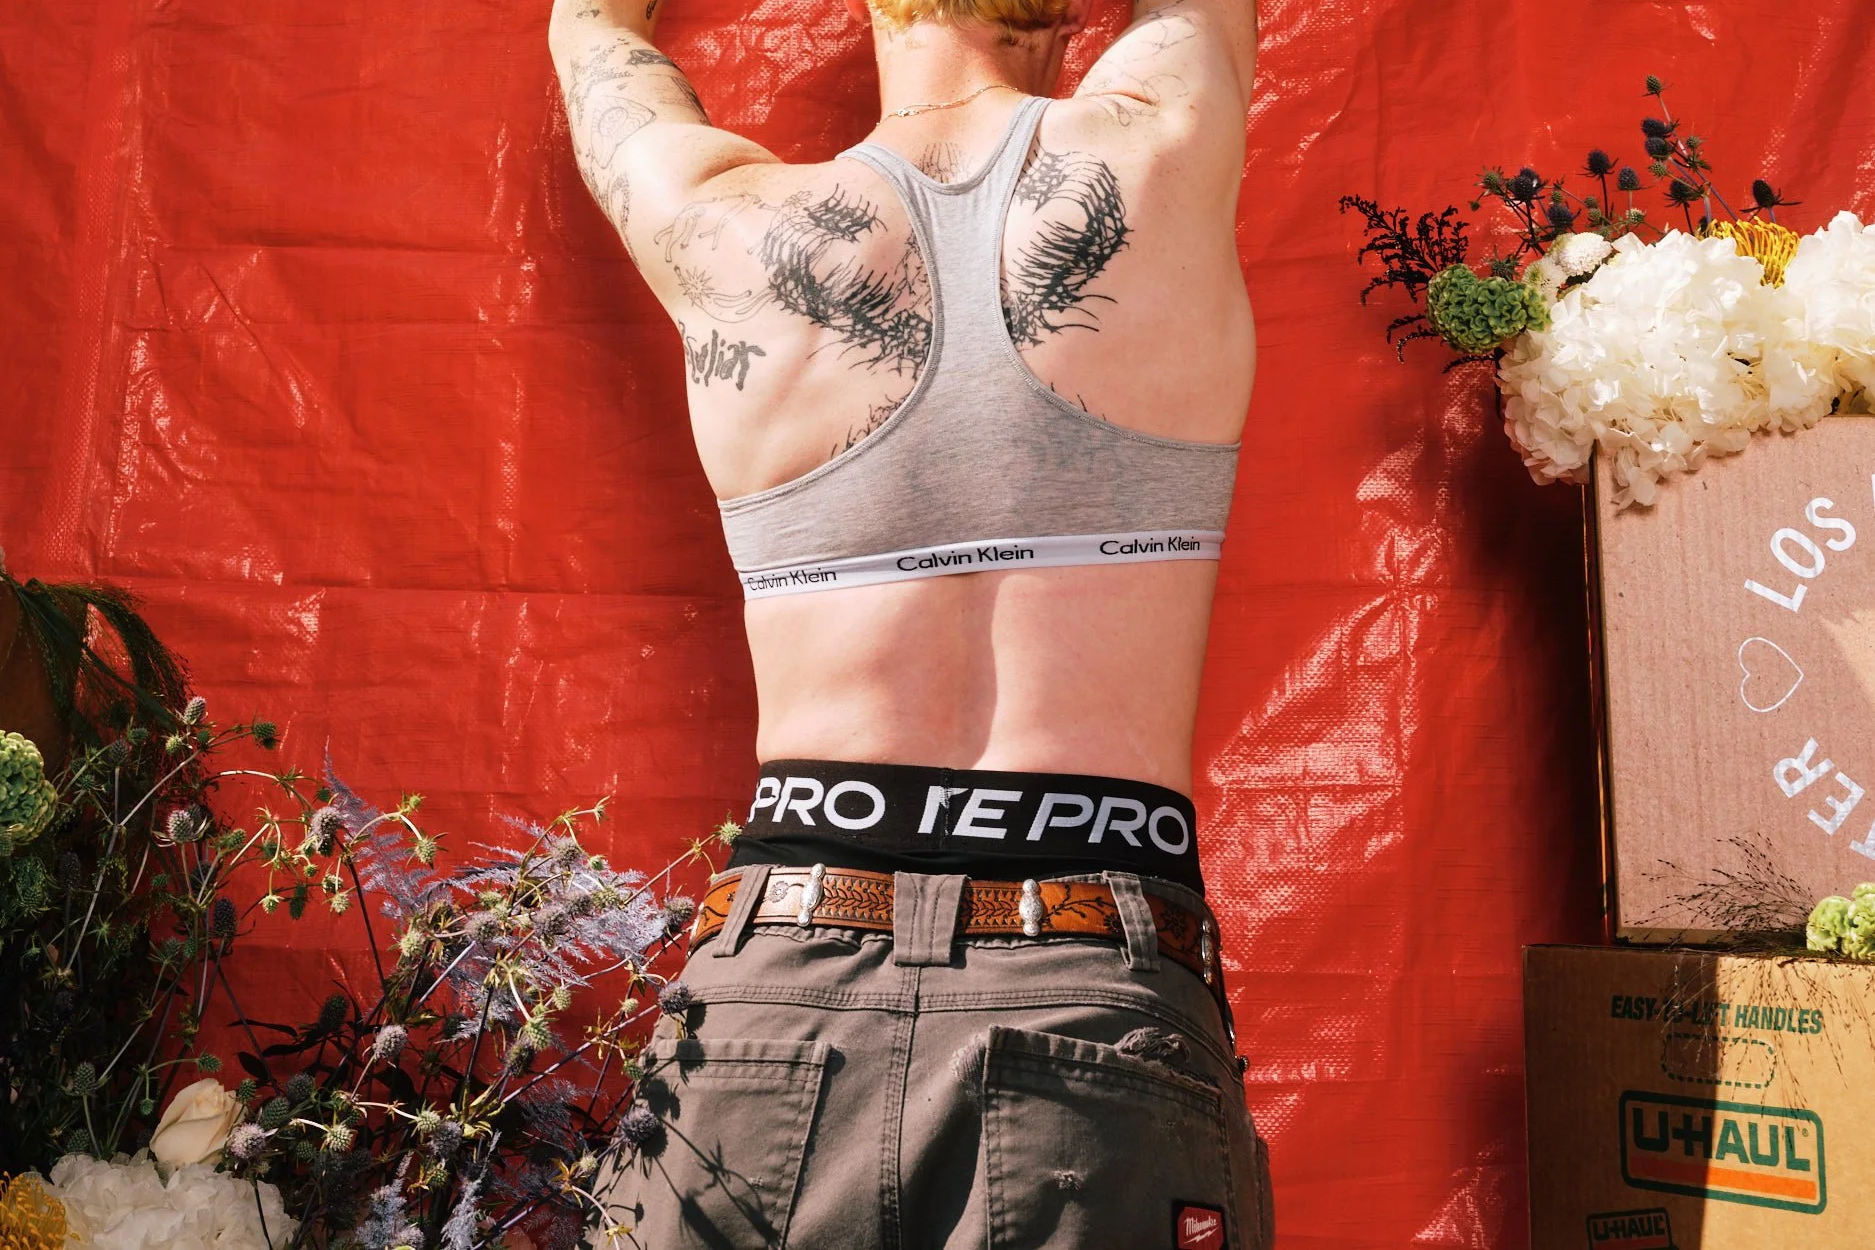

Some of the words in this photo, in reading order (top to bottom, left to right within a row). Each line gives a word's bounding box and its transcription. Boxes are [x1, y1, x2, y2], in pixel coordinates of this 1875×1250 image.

[896, 550, 972, 571] Calvin
[976, 544, 1034, 563] Klein
[1099, 537, 1164, 556] Calvin
[1167, 536, 1201, 552] Klein
[1743, 496, 1857, 613] LOS
[747, 573, 788, 591] Calvin
[789, 567, 837, 586] Klein
[747, 776, 886, 830] PRO
[1026, 792, 1190, 855] PRO
[1734, 1004, 1824, 1035] HANDLES
